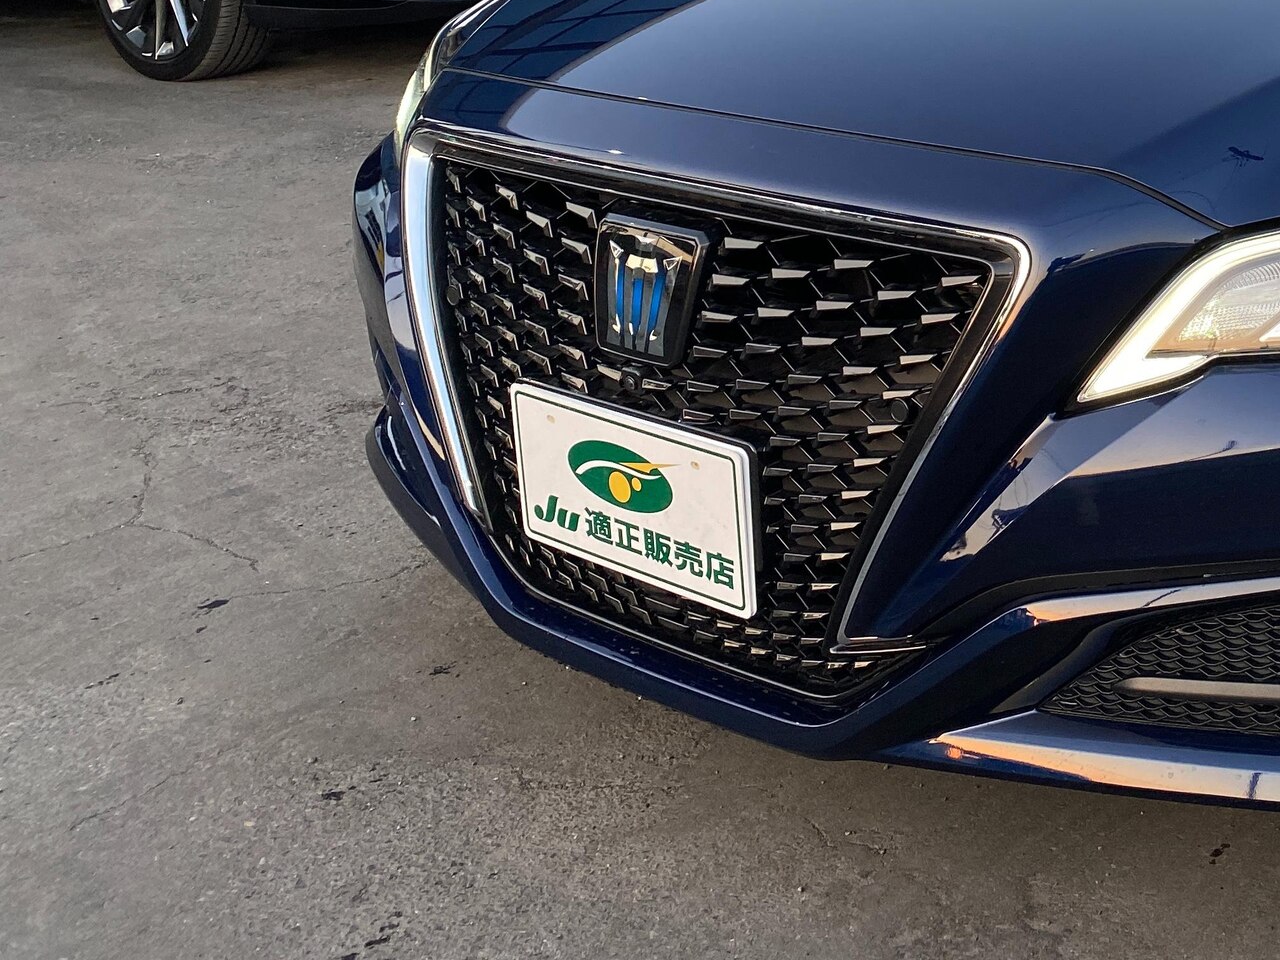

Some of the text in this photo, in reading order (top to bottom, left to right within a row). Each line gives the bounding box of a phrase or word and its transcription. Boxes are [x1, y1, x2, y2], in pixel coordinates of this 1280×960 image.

[584, 506, 735, 590] 適正販売店
